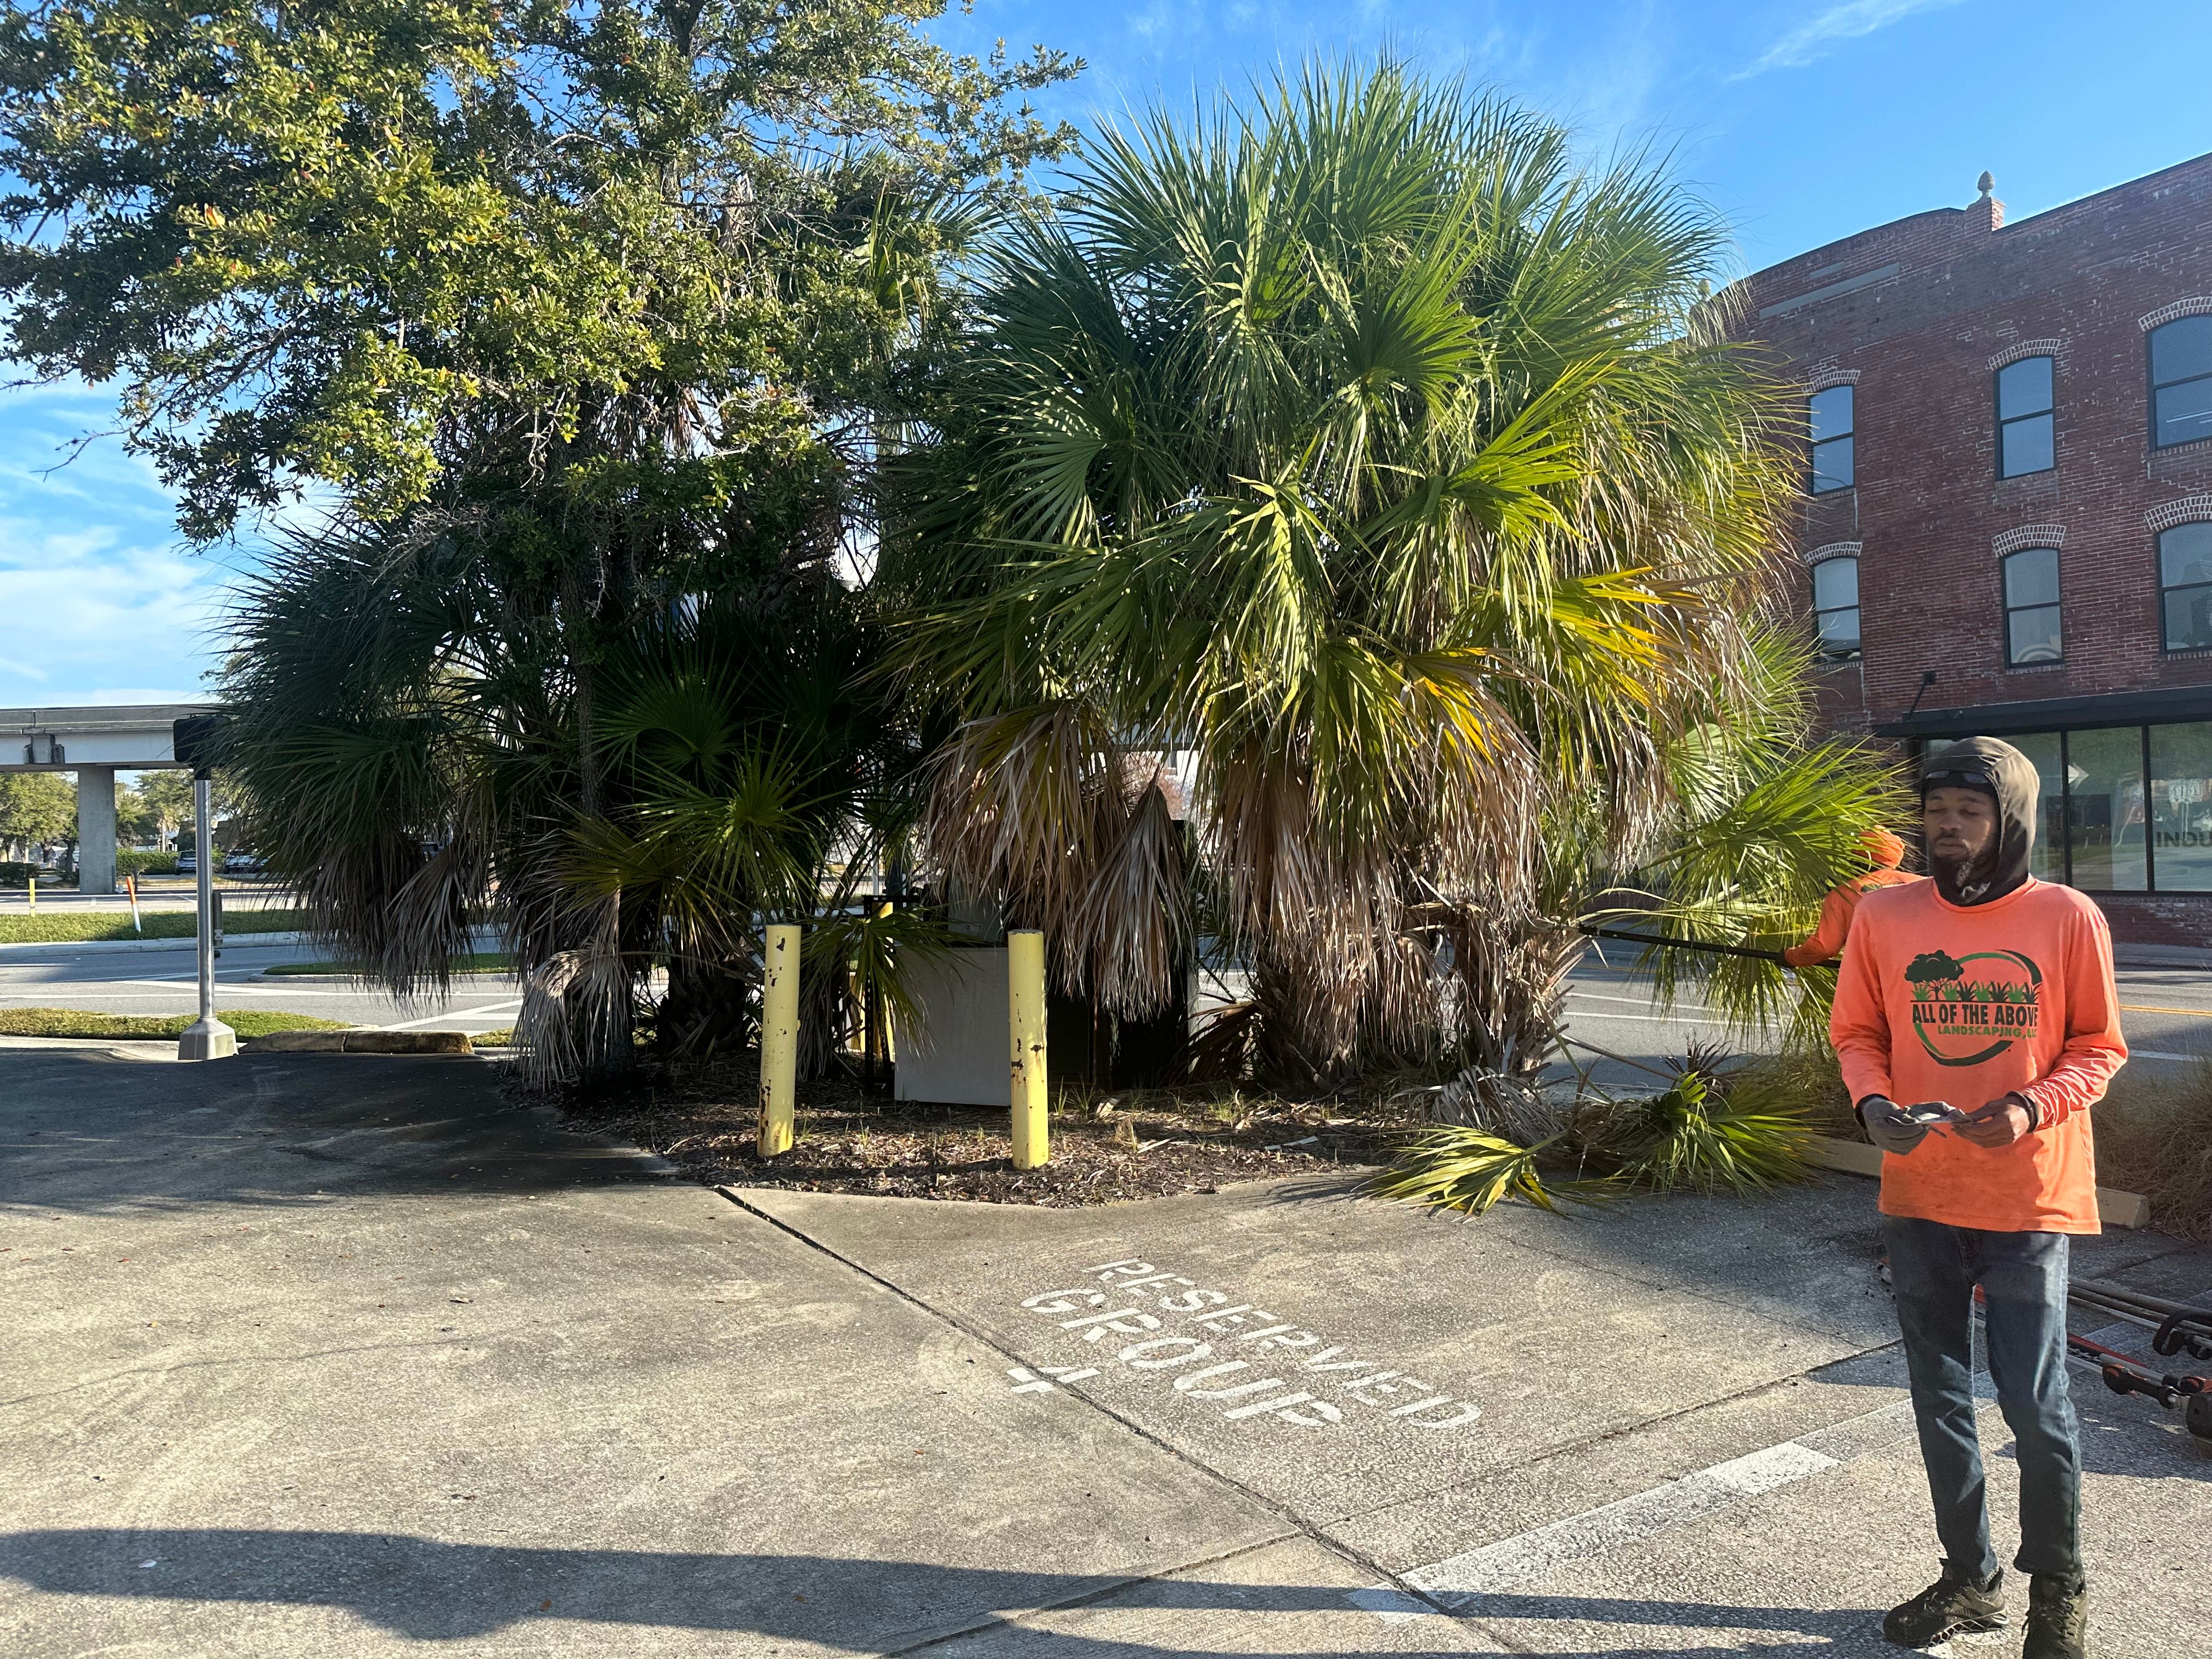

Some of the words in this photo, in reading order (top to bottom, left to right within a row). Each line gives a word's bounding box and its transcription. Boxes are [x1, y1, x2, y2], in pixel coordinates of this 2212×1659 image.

[1912, 1004, 1936, 1023] ALL
[1939, 1004, 1957, 1024] OF
[1962, 1005, 1988, 1025] THE
[1995, 1006, 2038, 1026] ABOVE
[1938, 1025, 2026, 1040] LANDSCAPING,
[1020, 1288, 1344, 1426] GROUP
[1080, 1258, 1484, 1427] RESERVED
